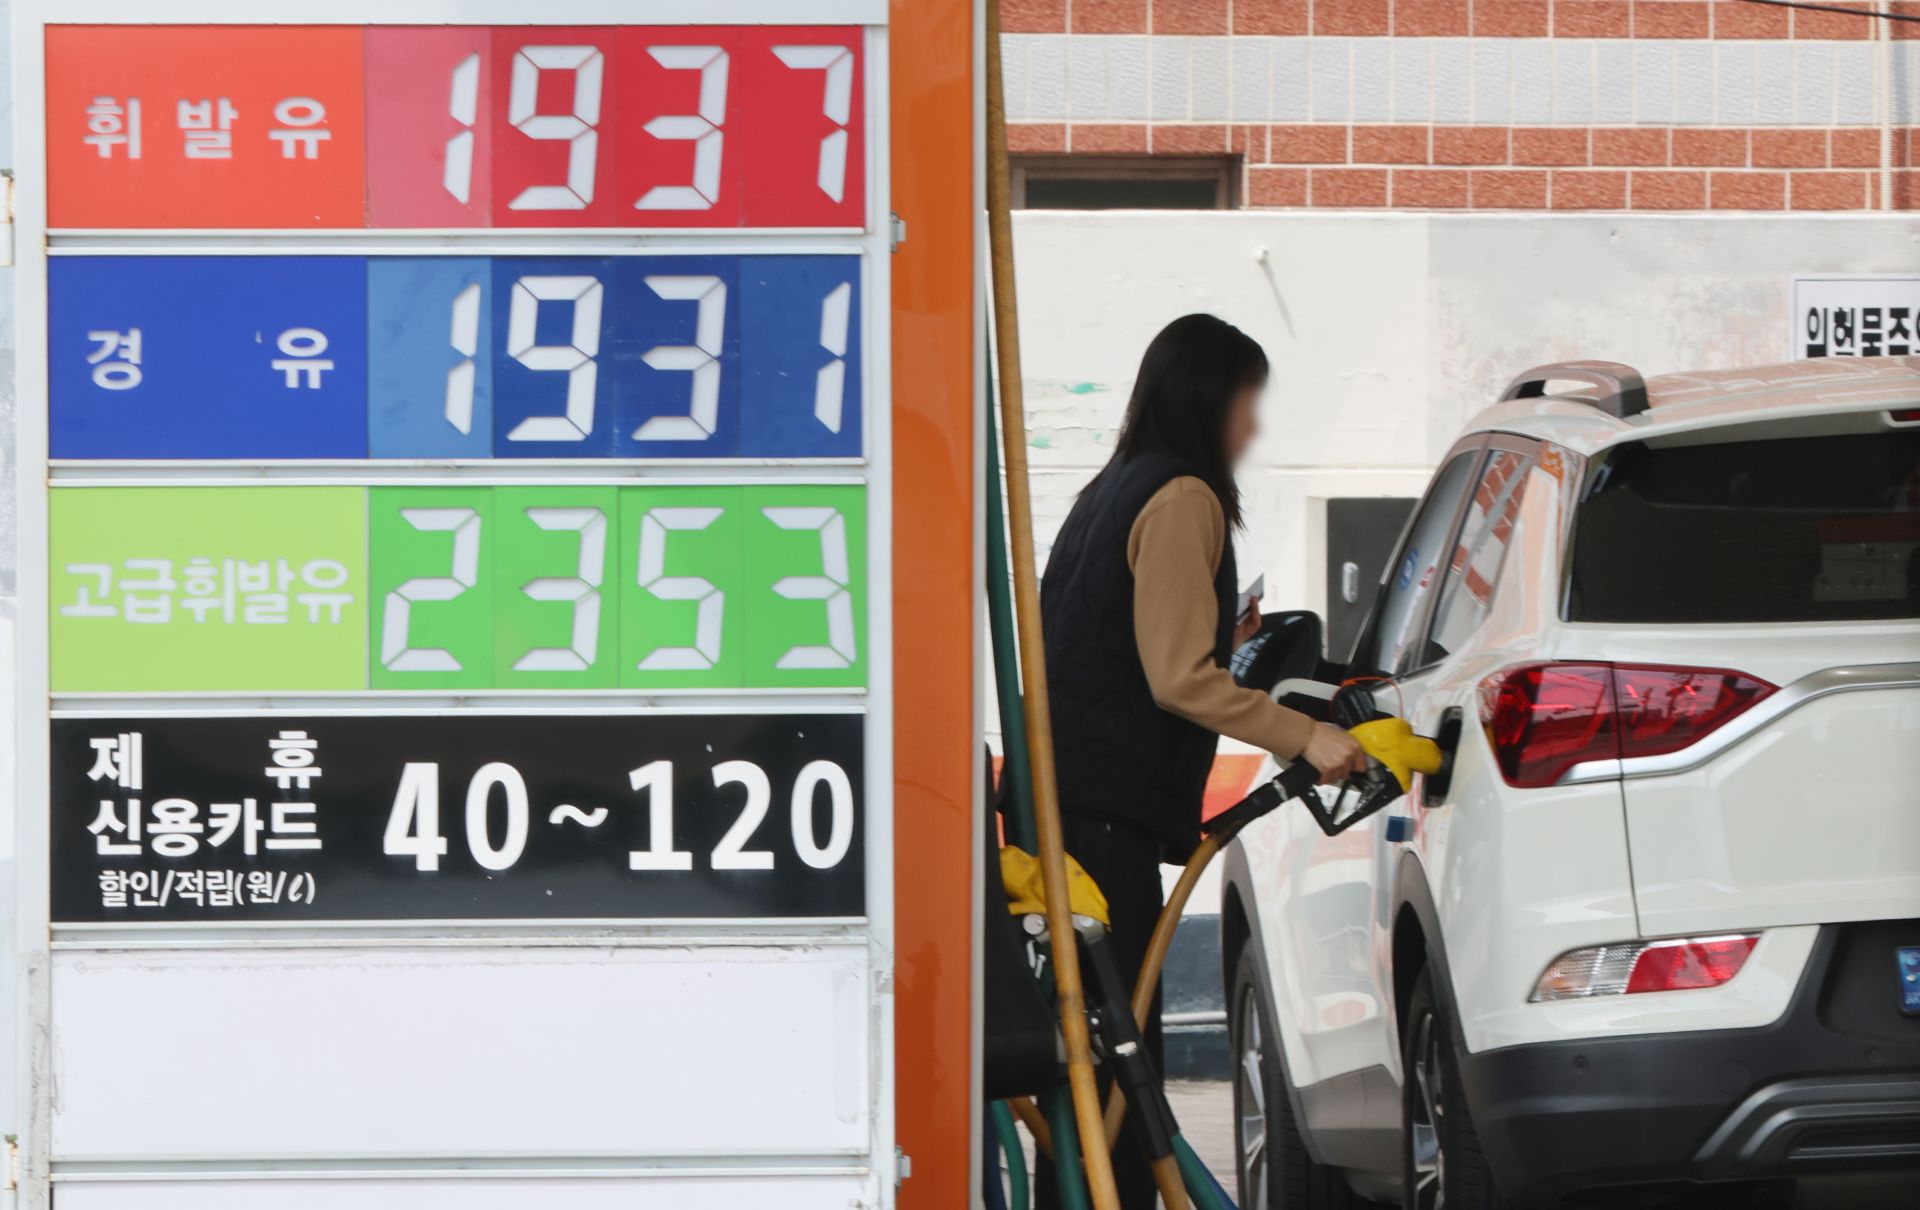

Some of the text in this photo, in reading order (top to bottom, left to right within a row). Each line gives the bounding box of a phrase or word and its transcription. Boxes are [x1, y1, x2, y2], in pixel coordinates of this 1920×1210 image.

[444, 45, 854, 211] 1937
[444, 275, 851, 442] 1931
[60, 506, 857, 671] 고급휘발유 2353
[87, 760, 854, 872] 신용카드 40~120
